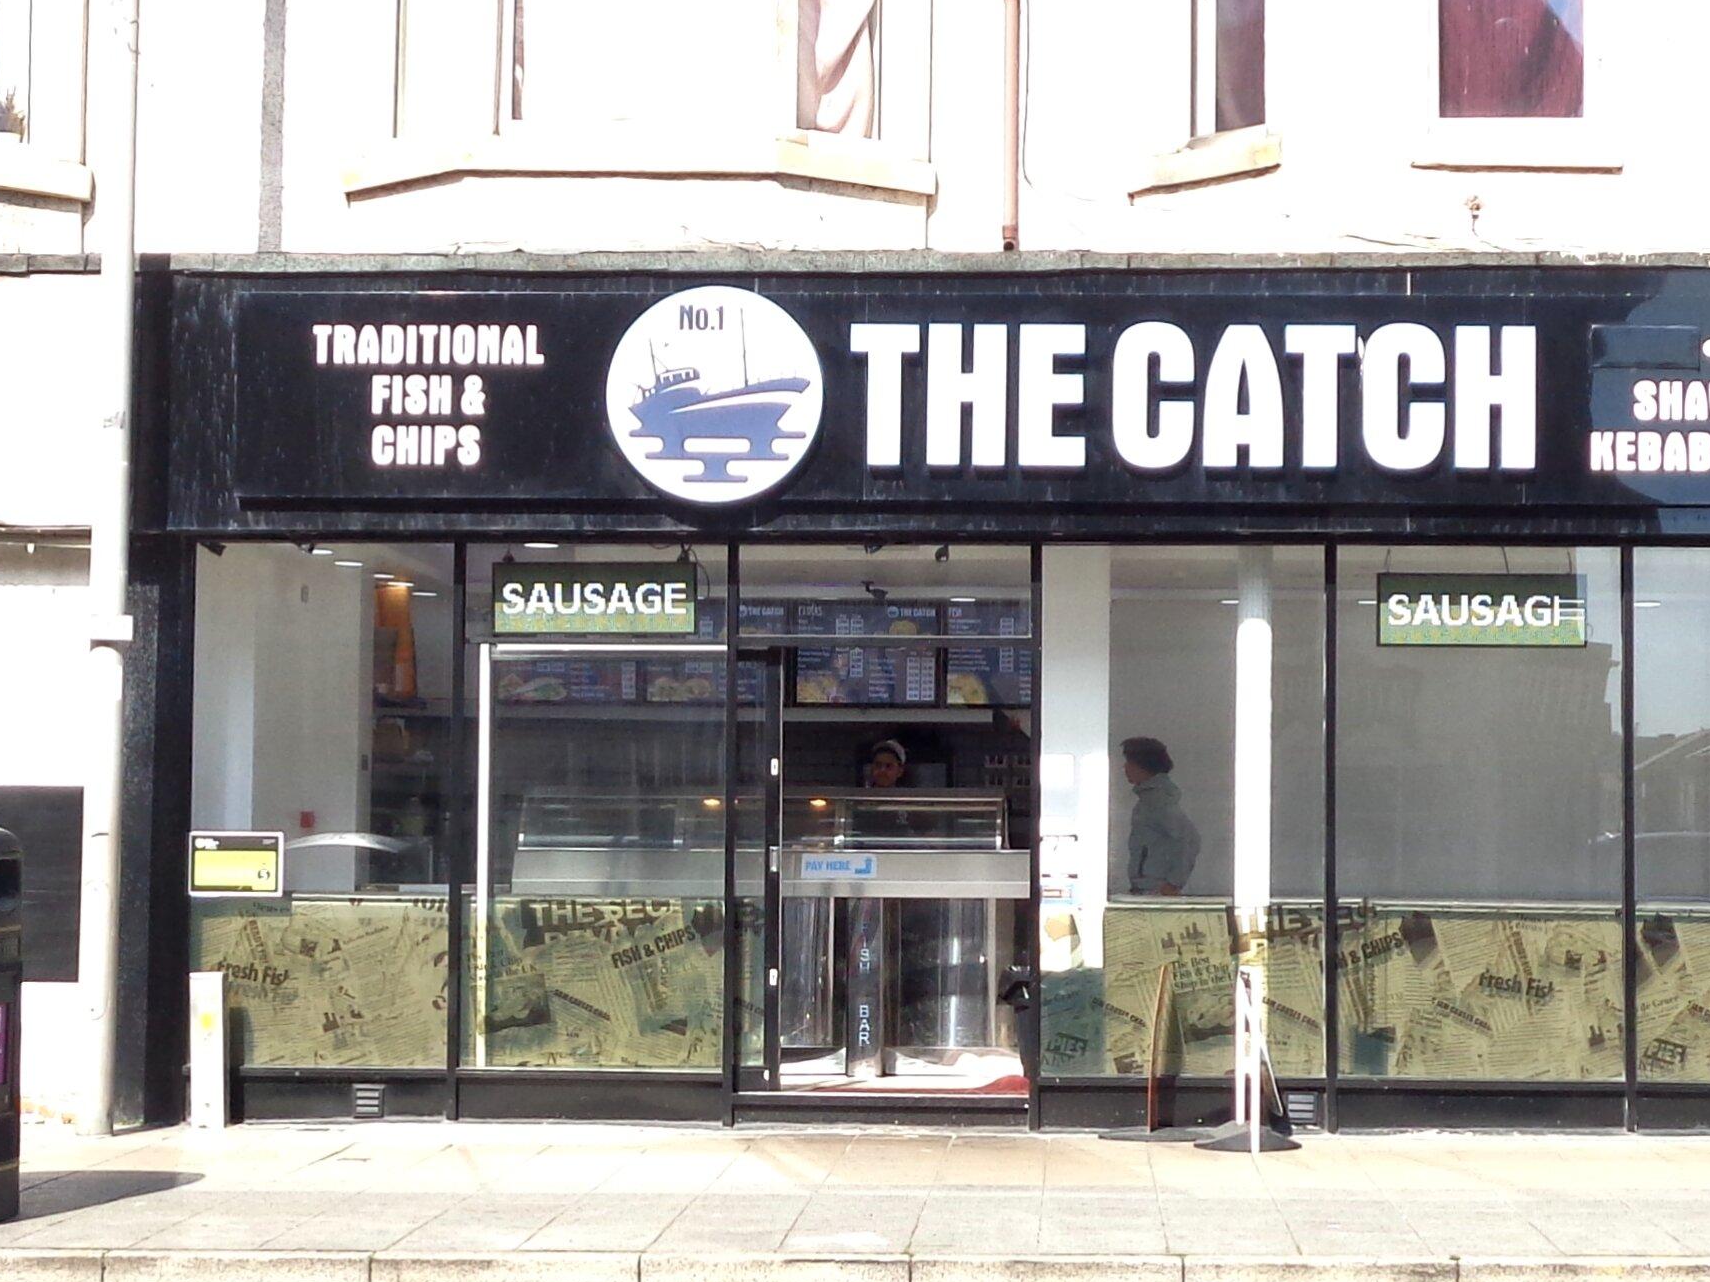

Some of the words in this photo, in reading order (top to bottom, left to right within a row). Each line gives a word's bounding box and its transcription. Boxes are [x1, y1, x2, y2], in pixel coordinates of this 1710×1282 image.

[679, 304, 724, 330] No.1
[312, 324, 545, 365] TRADITIONAL
[371, 374, 453, 415] FISH
[460, 374, 486, 415] &
[850, 323, 1086, 467] THE
[1112, 321, 1537, 470] CATCH
[371, 424, 481, 466] CHIPS
[501, 582, 688, 615] SAUSAGE
[805, 860, 823, 871] PAY
[825, 860, 852, 871] HERE
[611, 947, 643, 969] FISH
[654, 924, 697, 954] CHIPS
[1361, 931, 1404, 960] CHIPS
[217, 956, 258, 982] Fresh
[1479, 967, 1522, 994] Fresh
[859, 1004, 871, 1046] BAR
